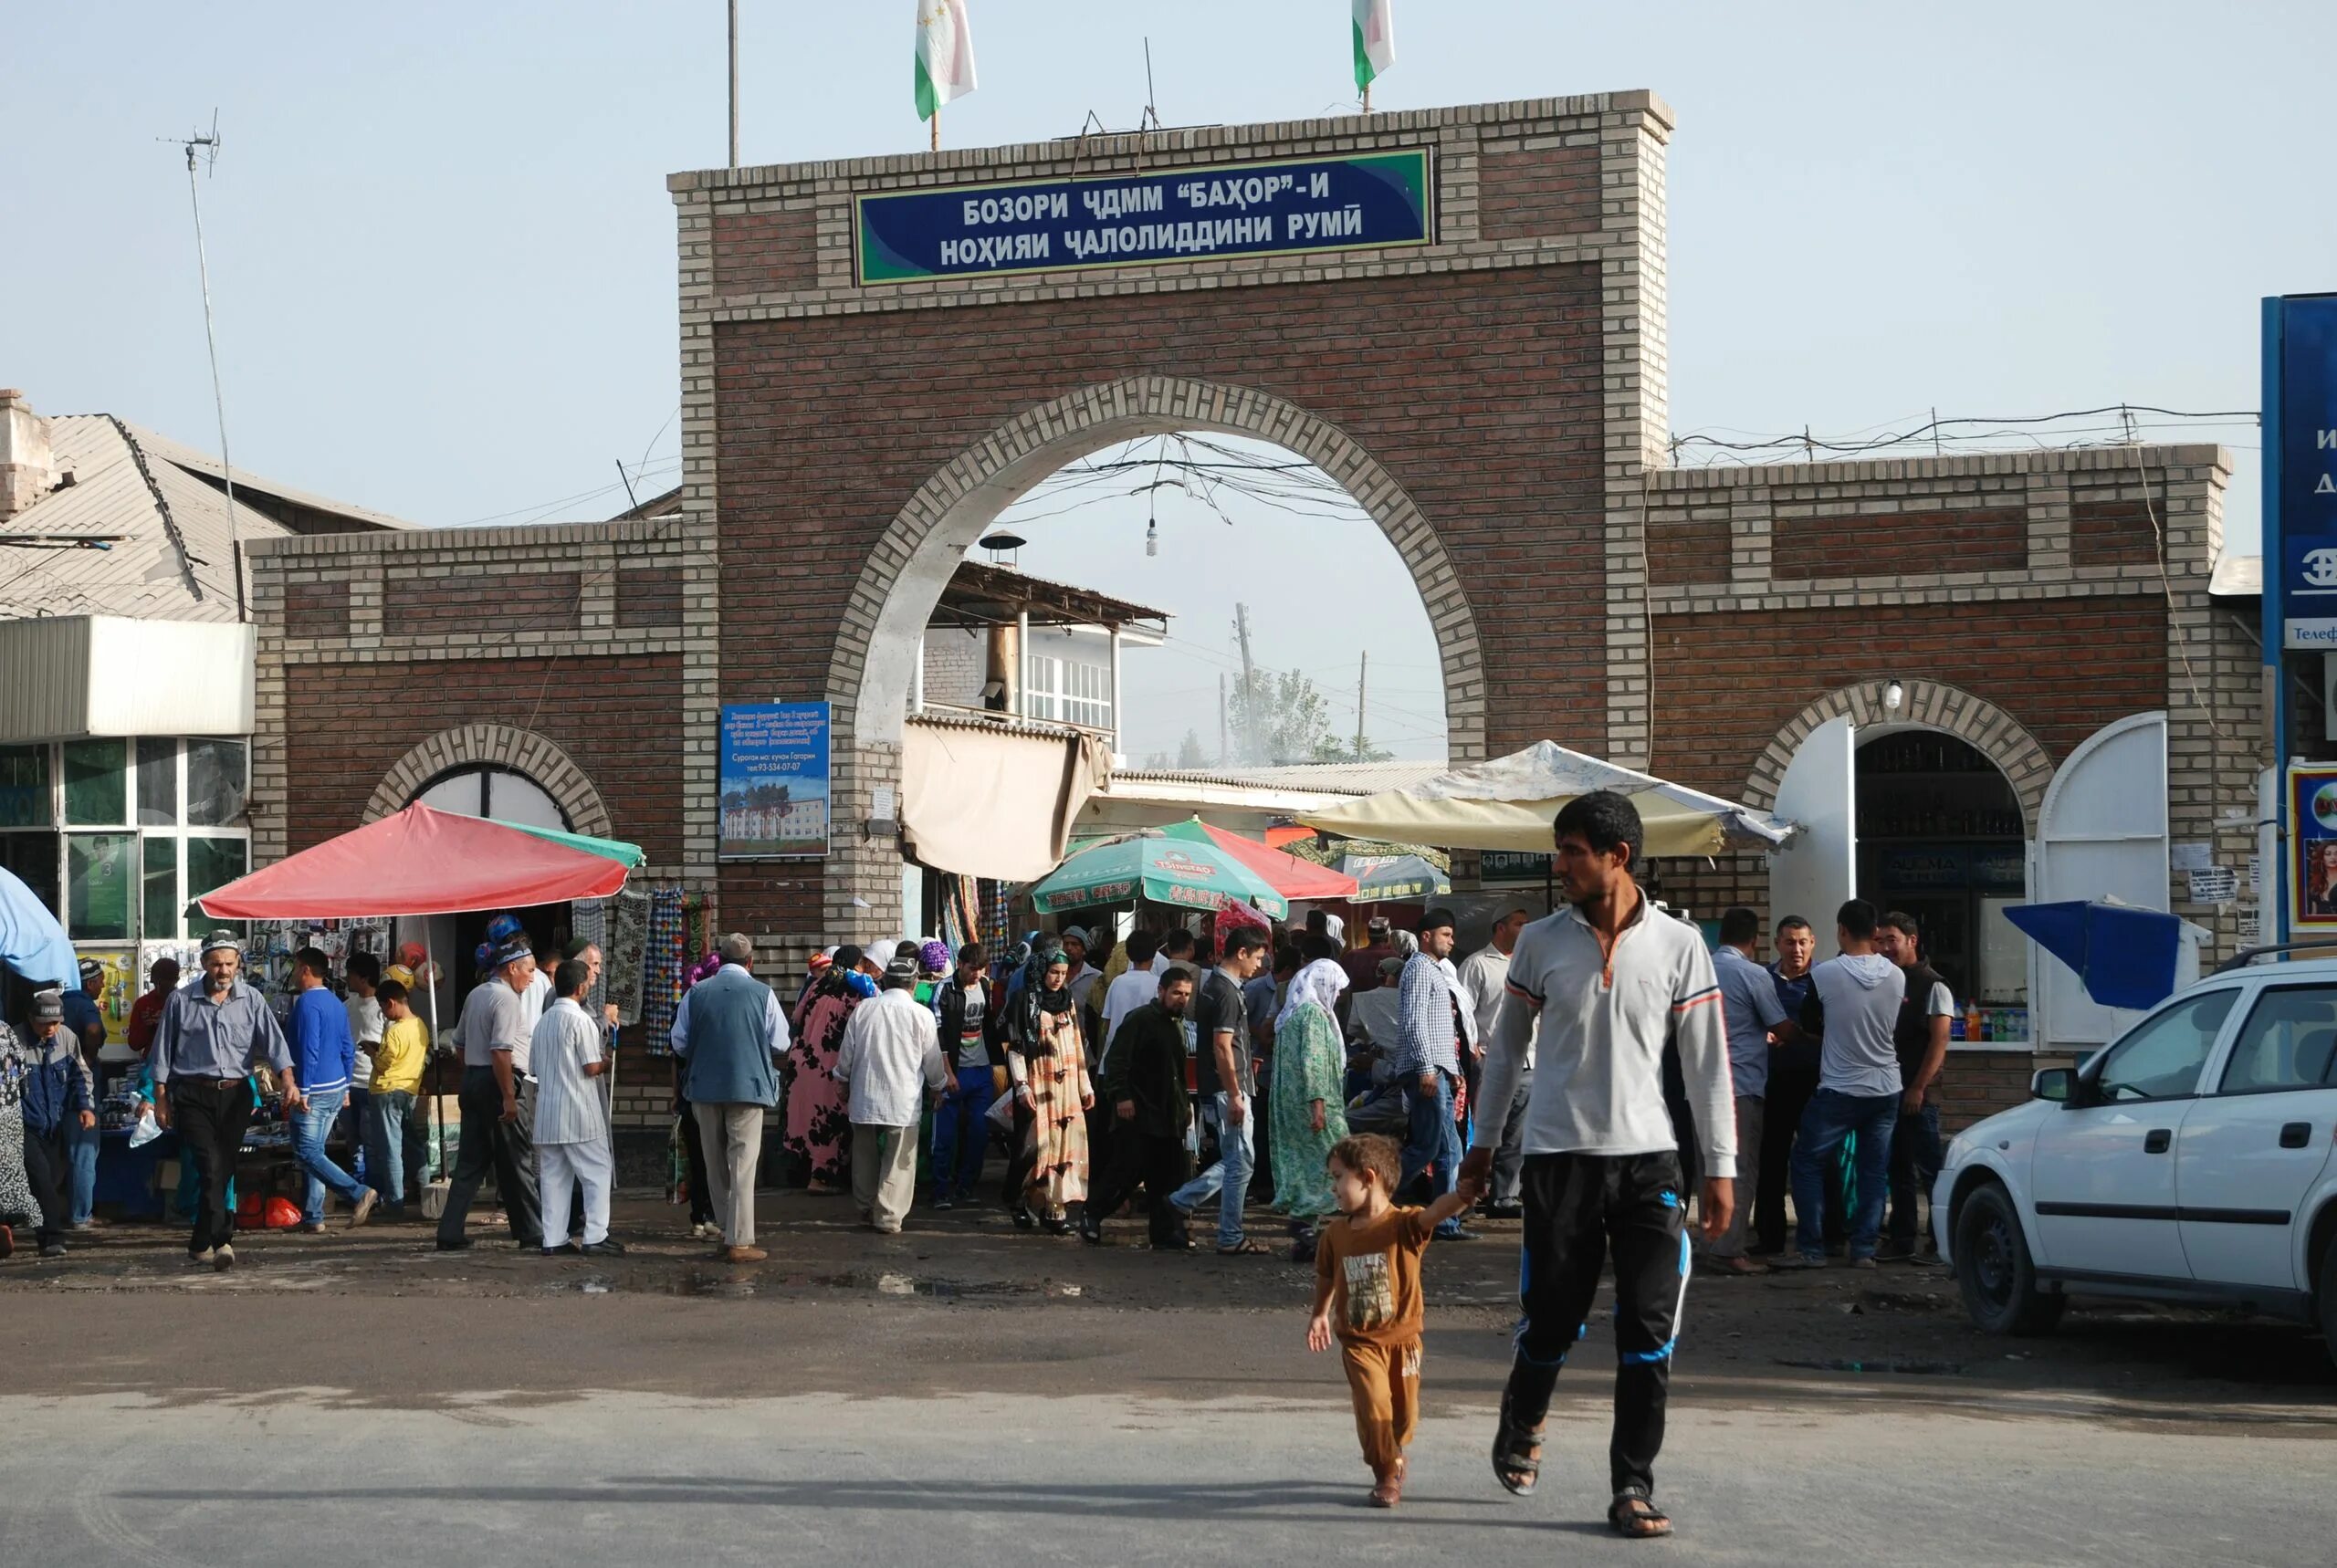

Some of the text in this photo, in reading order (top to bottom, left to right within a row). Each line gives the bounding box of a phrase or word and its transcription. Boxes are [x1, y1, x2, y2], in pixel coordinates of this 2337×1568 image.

[963, 193, 1069, 225] БОЗОРИ
[1083, 185, 1164, 221] ҶДММ
[940, 204, 1362, 267] НОҲИЯИ ҶАЛОЛИДДИНИ РУМӢ
[790, 751, 816, 761] Гагарин
